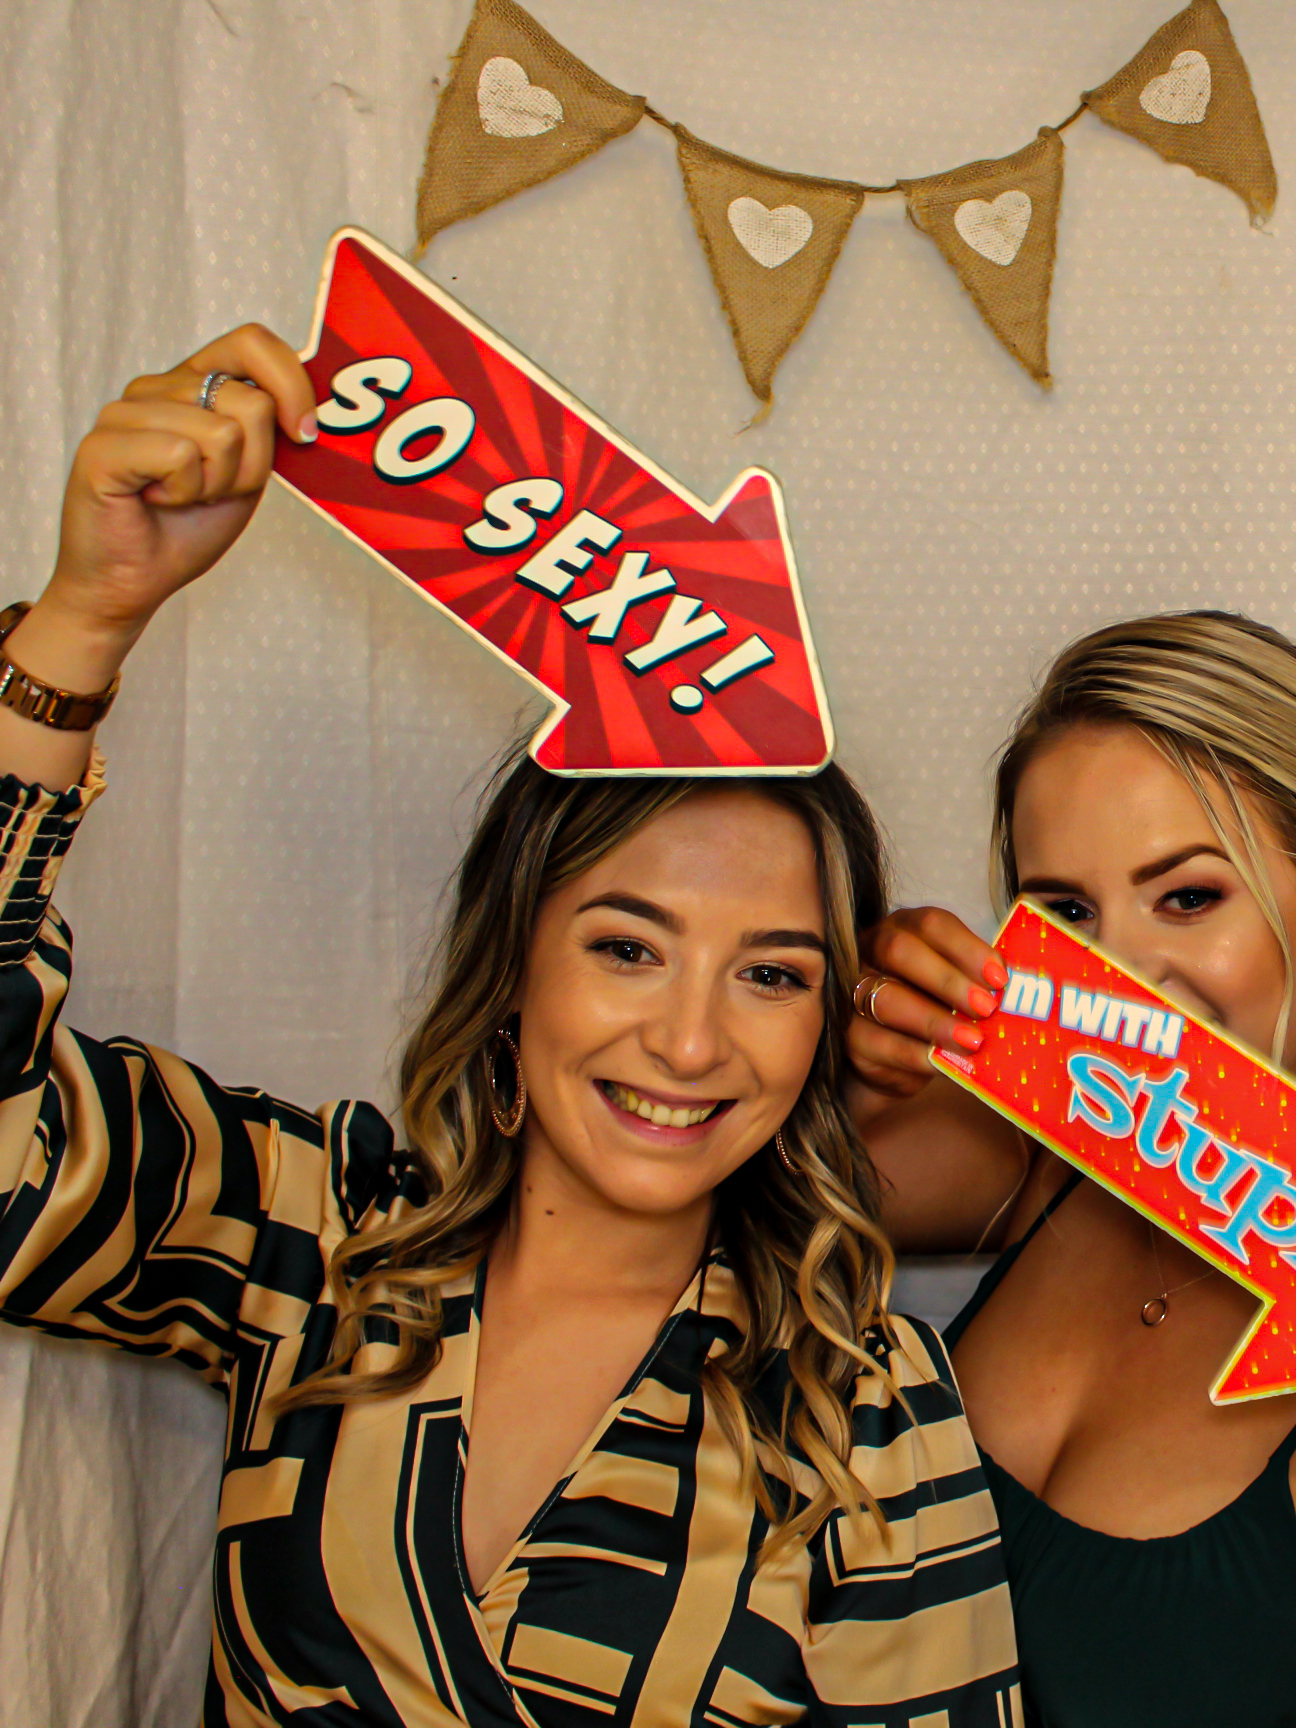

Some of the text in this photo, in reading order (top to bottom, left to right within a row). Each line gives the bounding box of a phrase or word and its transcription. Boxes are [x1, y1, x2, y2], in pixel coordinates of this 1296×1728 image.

[316, 357, 775, 715] SO SEXY!
[1059, 986, 1185, 1059] WITH
